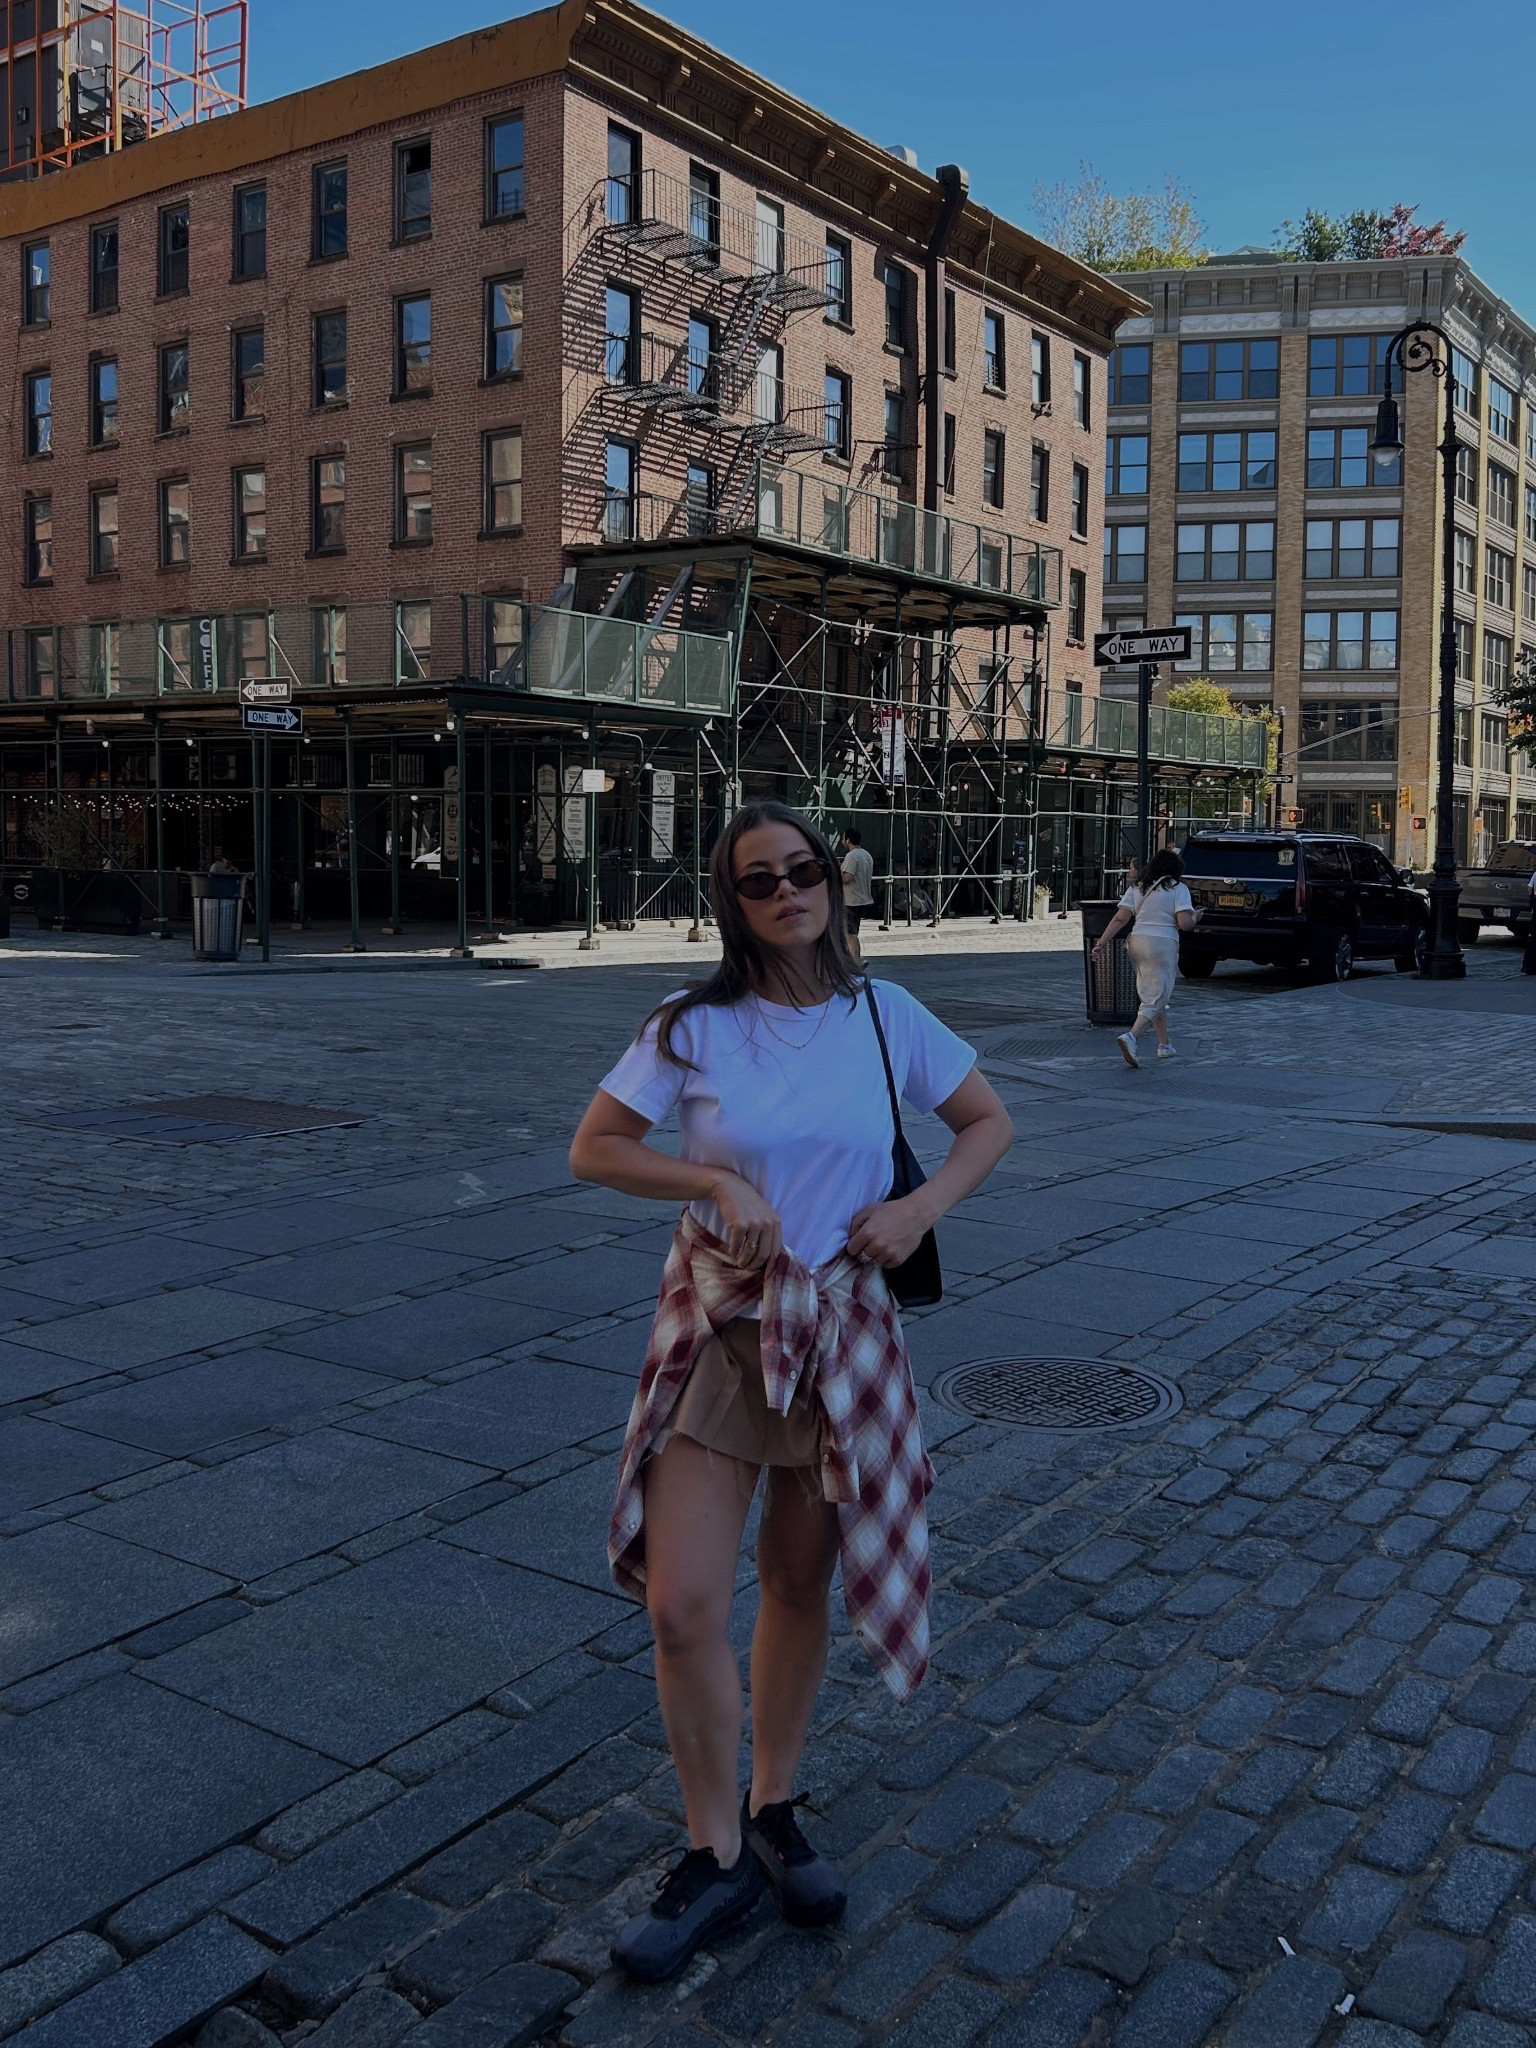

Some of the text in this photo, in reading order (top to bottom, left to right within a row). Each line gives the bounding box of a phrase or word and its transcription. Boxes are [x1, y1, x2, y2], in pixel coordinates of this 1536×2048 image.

[1109, 637, 1179, 655] ONE WAY
[247, 685, 285, 696] ONE WAY
[252, 712, 293, 725] ONE WAY
